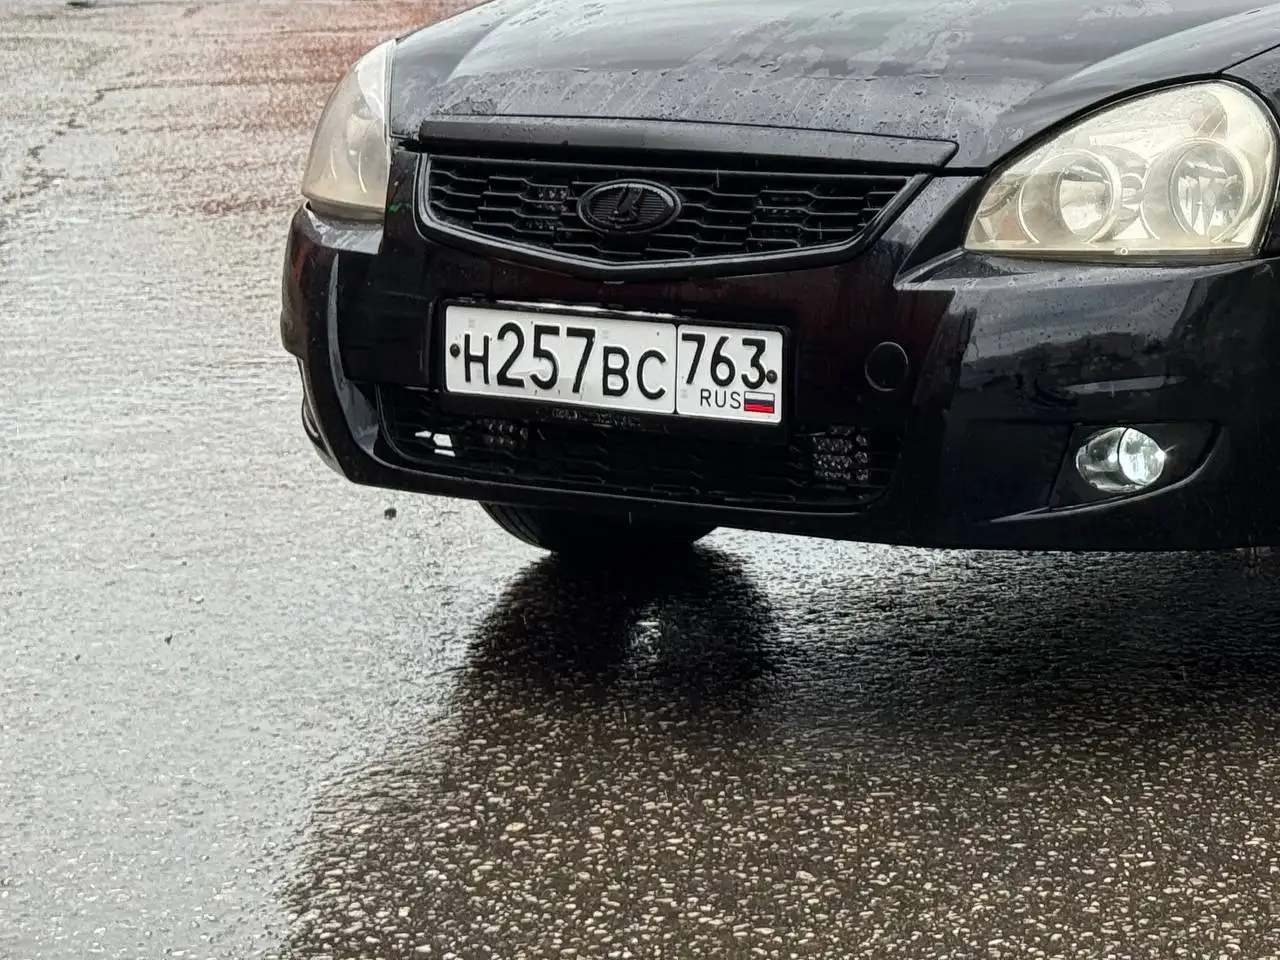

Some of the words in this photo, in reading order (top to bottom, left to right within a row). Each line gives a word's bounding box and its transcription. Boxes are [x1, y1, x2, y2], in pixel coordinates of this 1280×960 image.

[463, 321, 667, 400] Н257ВС
[681, 333, 767, 390] 763
[700, 388, 742, 410] RUS
